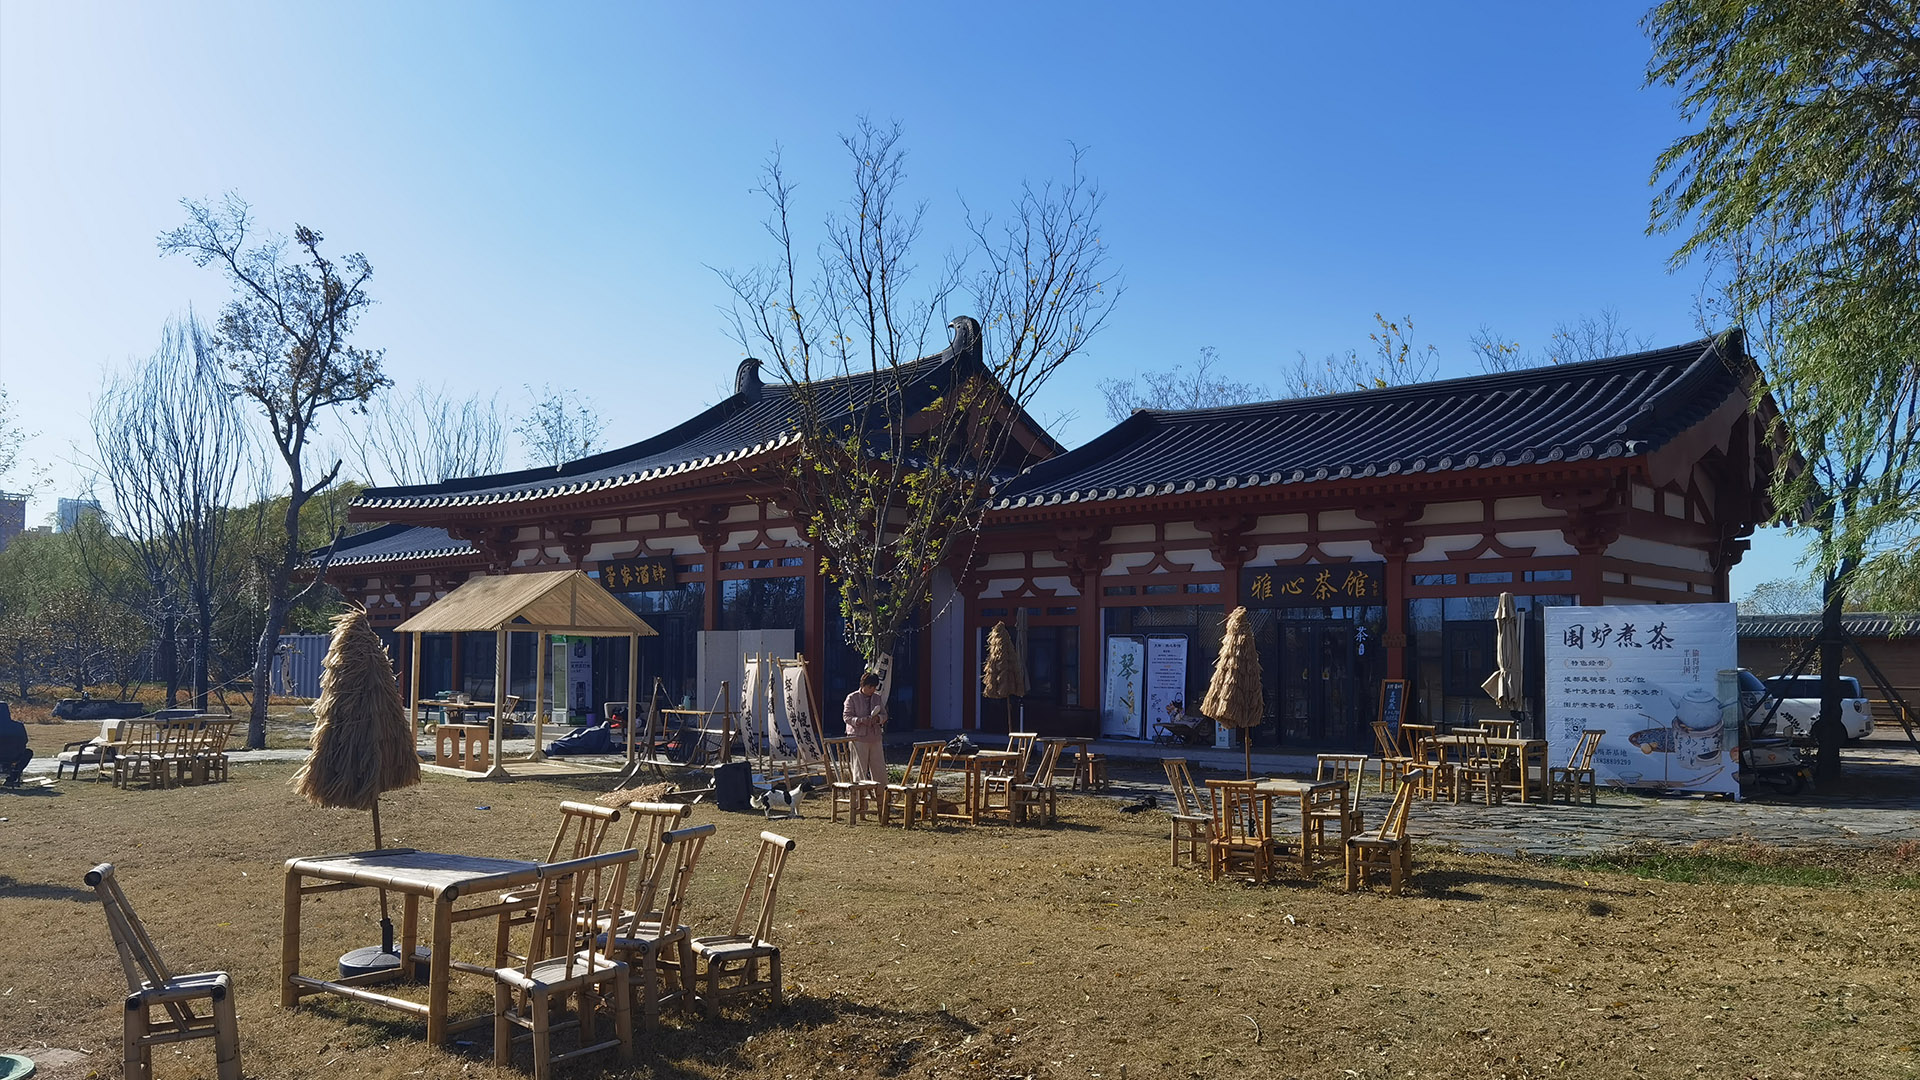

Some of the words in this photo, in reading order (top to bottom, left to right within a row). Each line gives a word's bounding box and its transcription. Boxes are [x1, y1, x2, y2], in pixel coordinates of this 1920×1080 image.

[1251, 569, 1368, 601] 雅心茶馆
[1355, 626, 1368, 642] 茶
[1563, 622, 1674, 650] 围炉煮茶
[1117, 653, 1139, 680] 琴
